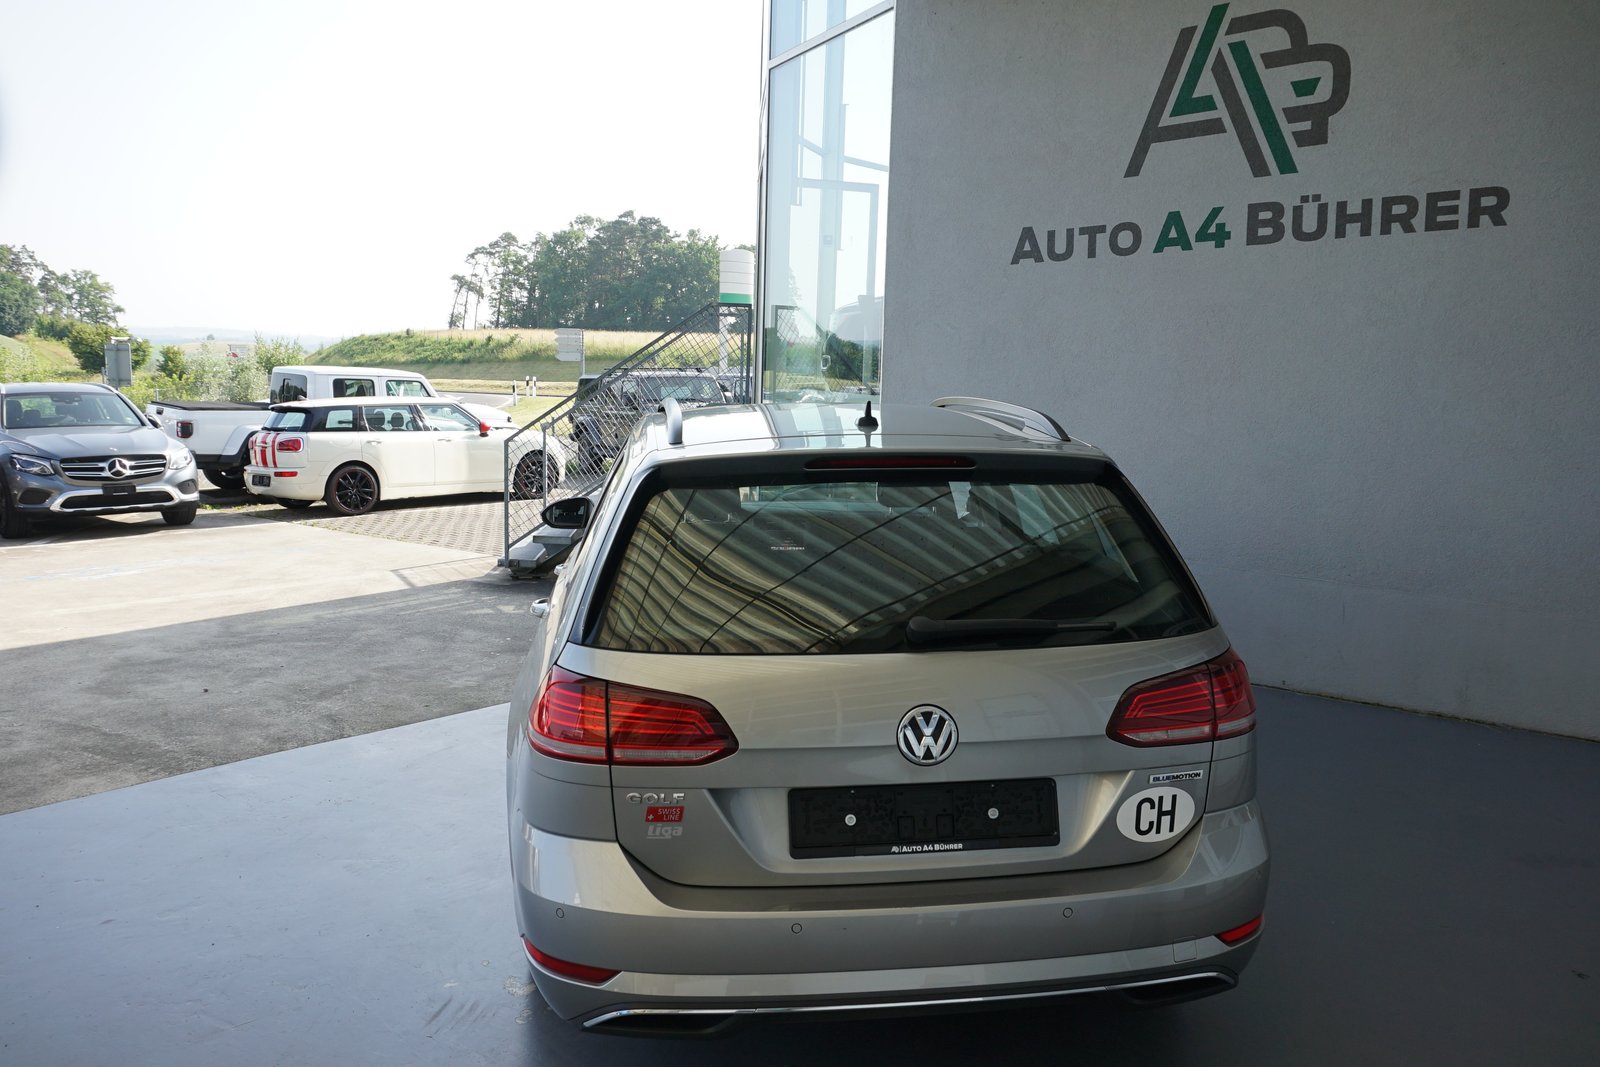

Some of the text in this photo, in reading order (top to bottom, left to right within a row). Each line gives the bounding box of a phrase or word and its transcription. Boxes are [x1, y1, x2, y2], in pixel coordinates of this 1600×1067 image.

[1010, 186, 1512, 265] AUTO A4 BÜHRER
[1152, 772, 1201, 782] BLUEMOTION
[625, 792, 685, 804] GOLF
[1134, 793, 1178, 836] CH
